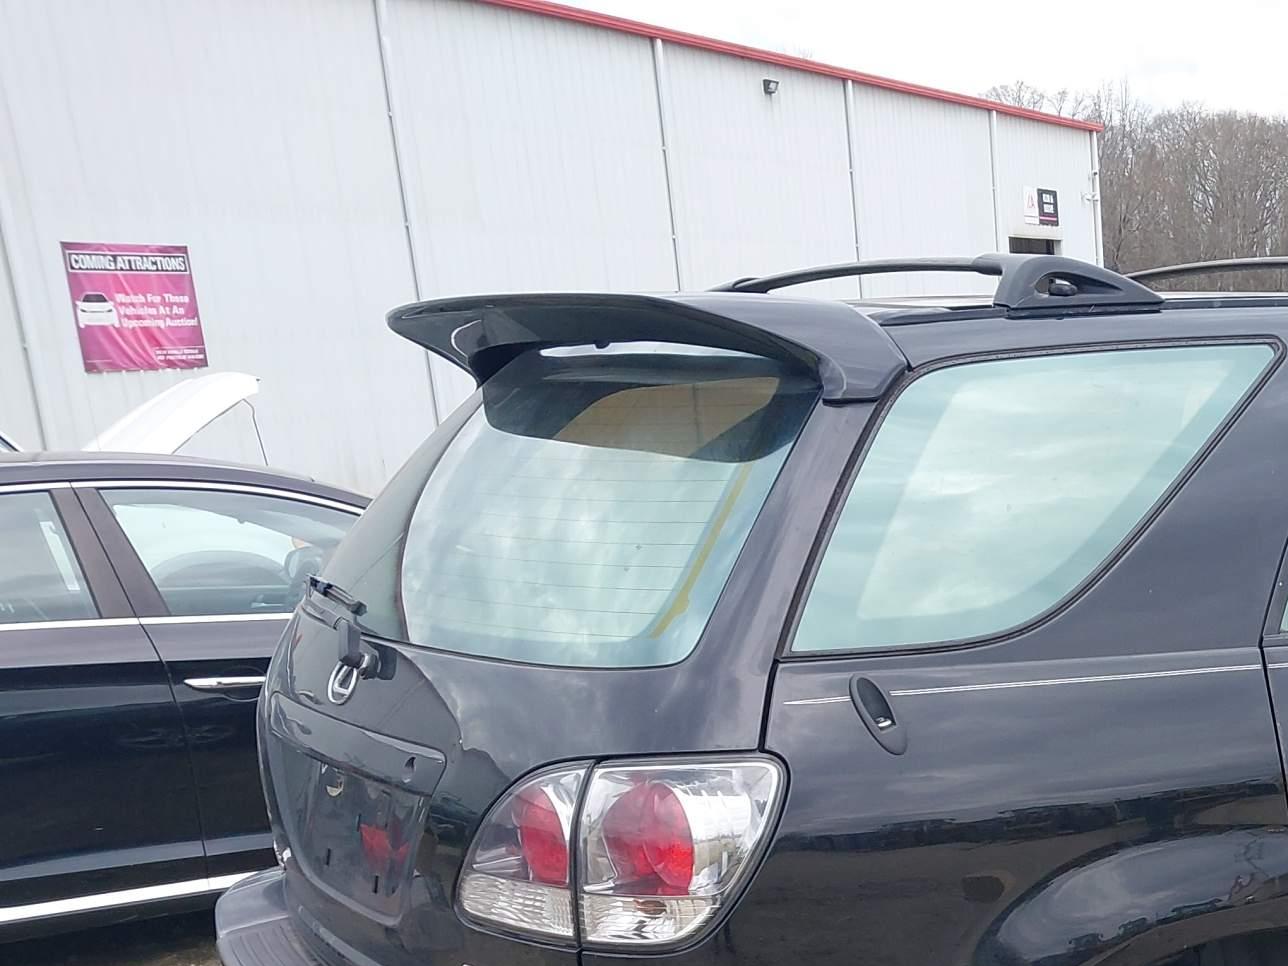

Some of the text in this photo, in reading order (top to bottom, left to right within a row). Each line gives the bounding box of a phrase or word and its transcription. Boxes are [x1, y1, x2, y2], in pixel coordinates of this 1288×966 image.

[70, 254, 185, 271] COMING ATTRACTIONS
[115, 293, 189, 303] Watch For These
[119, 305, 184, 315] Vehicles At An
[121, 317, 165, 328] Upcoming
